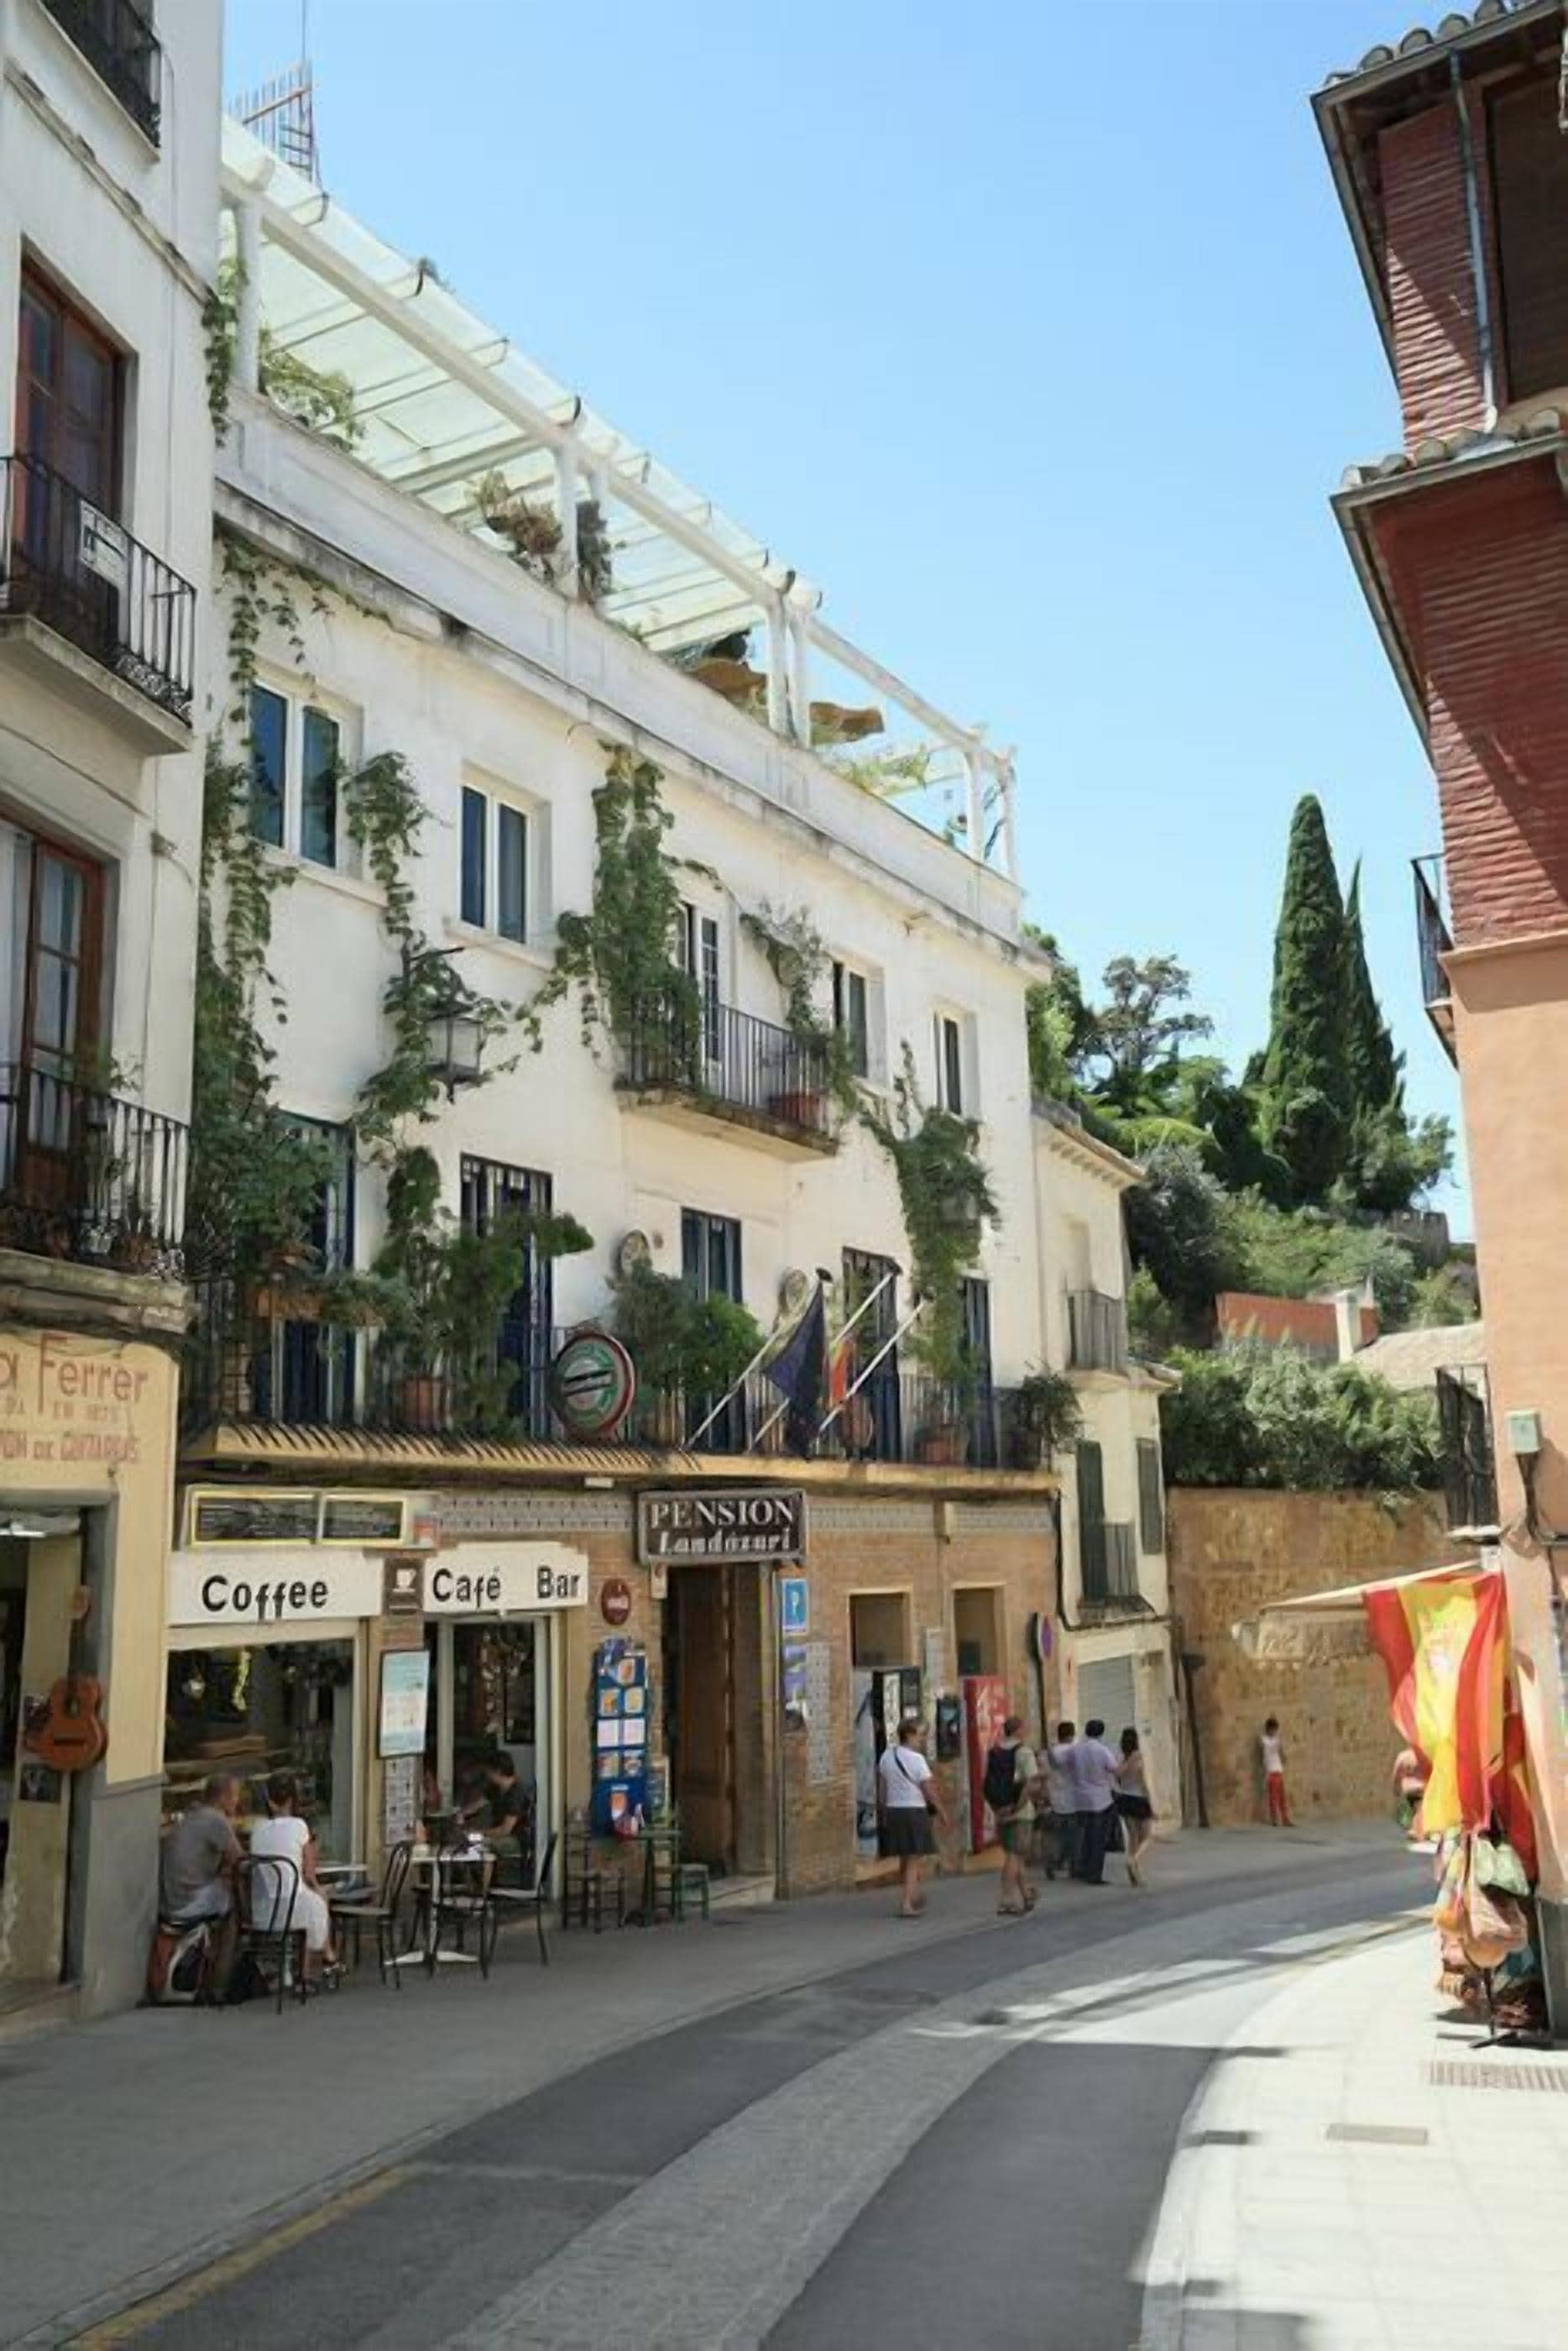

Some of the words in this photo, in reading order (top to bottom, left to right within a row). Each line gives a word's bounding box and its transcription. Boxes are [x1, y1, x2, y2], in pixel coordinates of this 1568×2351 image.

[39, 1333, 148, 1414] Ferrer
[651, 1500, 793, 1529] PENSION
[202, 1575, 328, 1620] Coffee
[432, 1566, 501, 1610] Café
[537, 1566, 580, 1599] Bar
